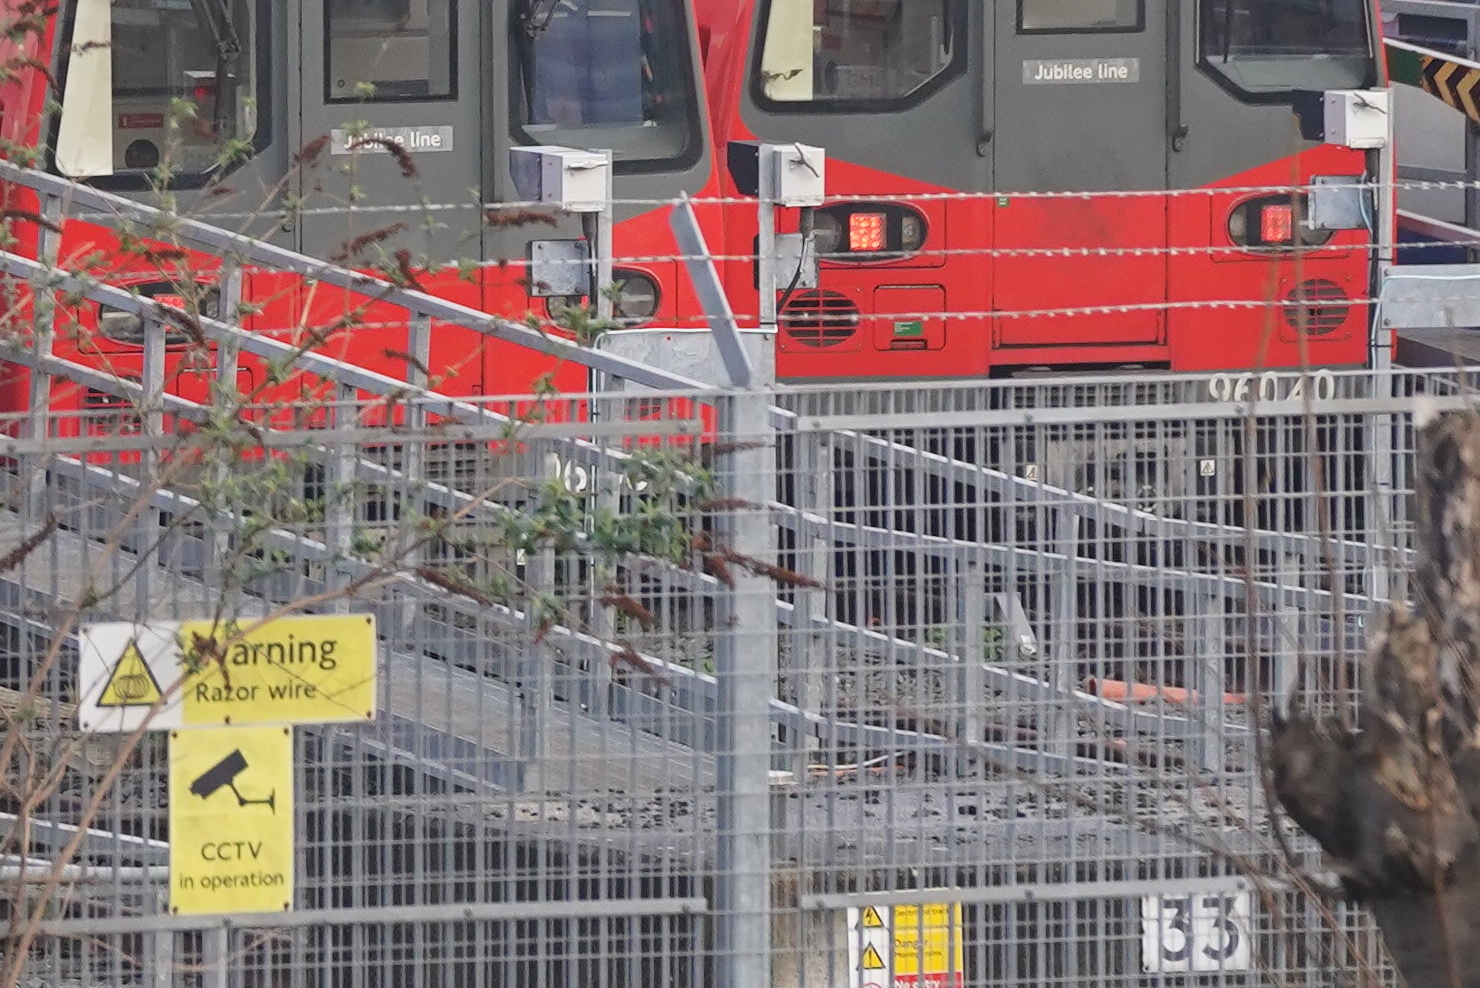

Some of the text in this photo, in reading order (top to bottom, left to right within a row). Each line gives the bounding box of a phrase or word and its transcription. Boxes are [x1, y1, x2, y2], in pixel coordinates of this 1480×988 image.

[1034, 63, 1128, 80] Jubilee line
[410, 131, 441, 148] line
[220, 634, 338, 670] arning
[269, 679, 317, 700] wire
[201, 841, 262, 861] CCTV
[179, 871, 284, 891] in operation
[1160, 898, 1239, 962] 33
